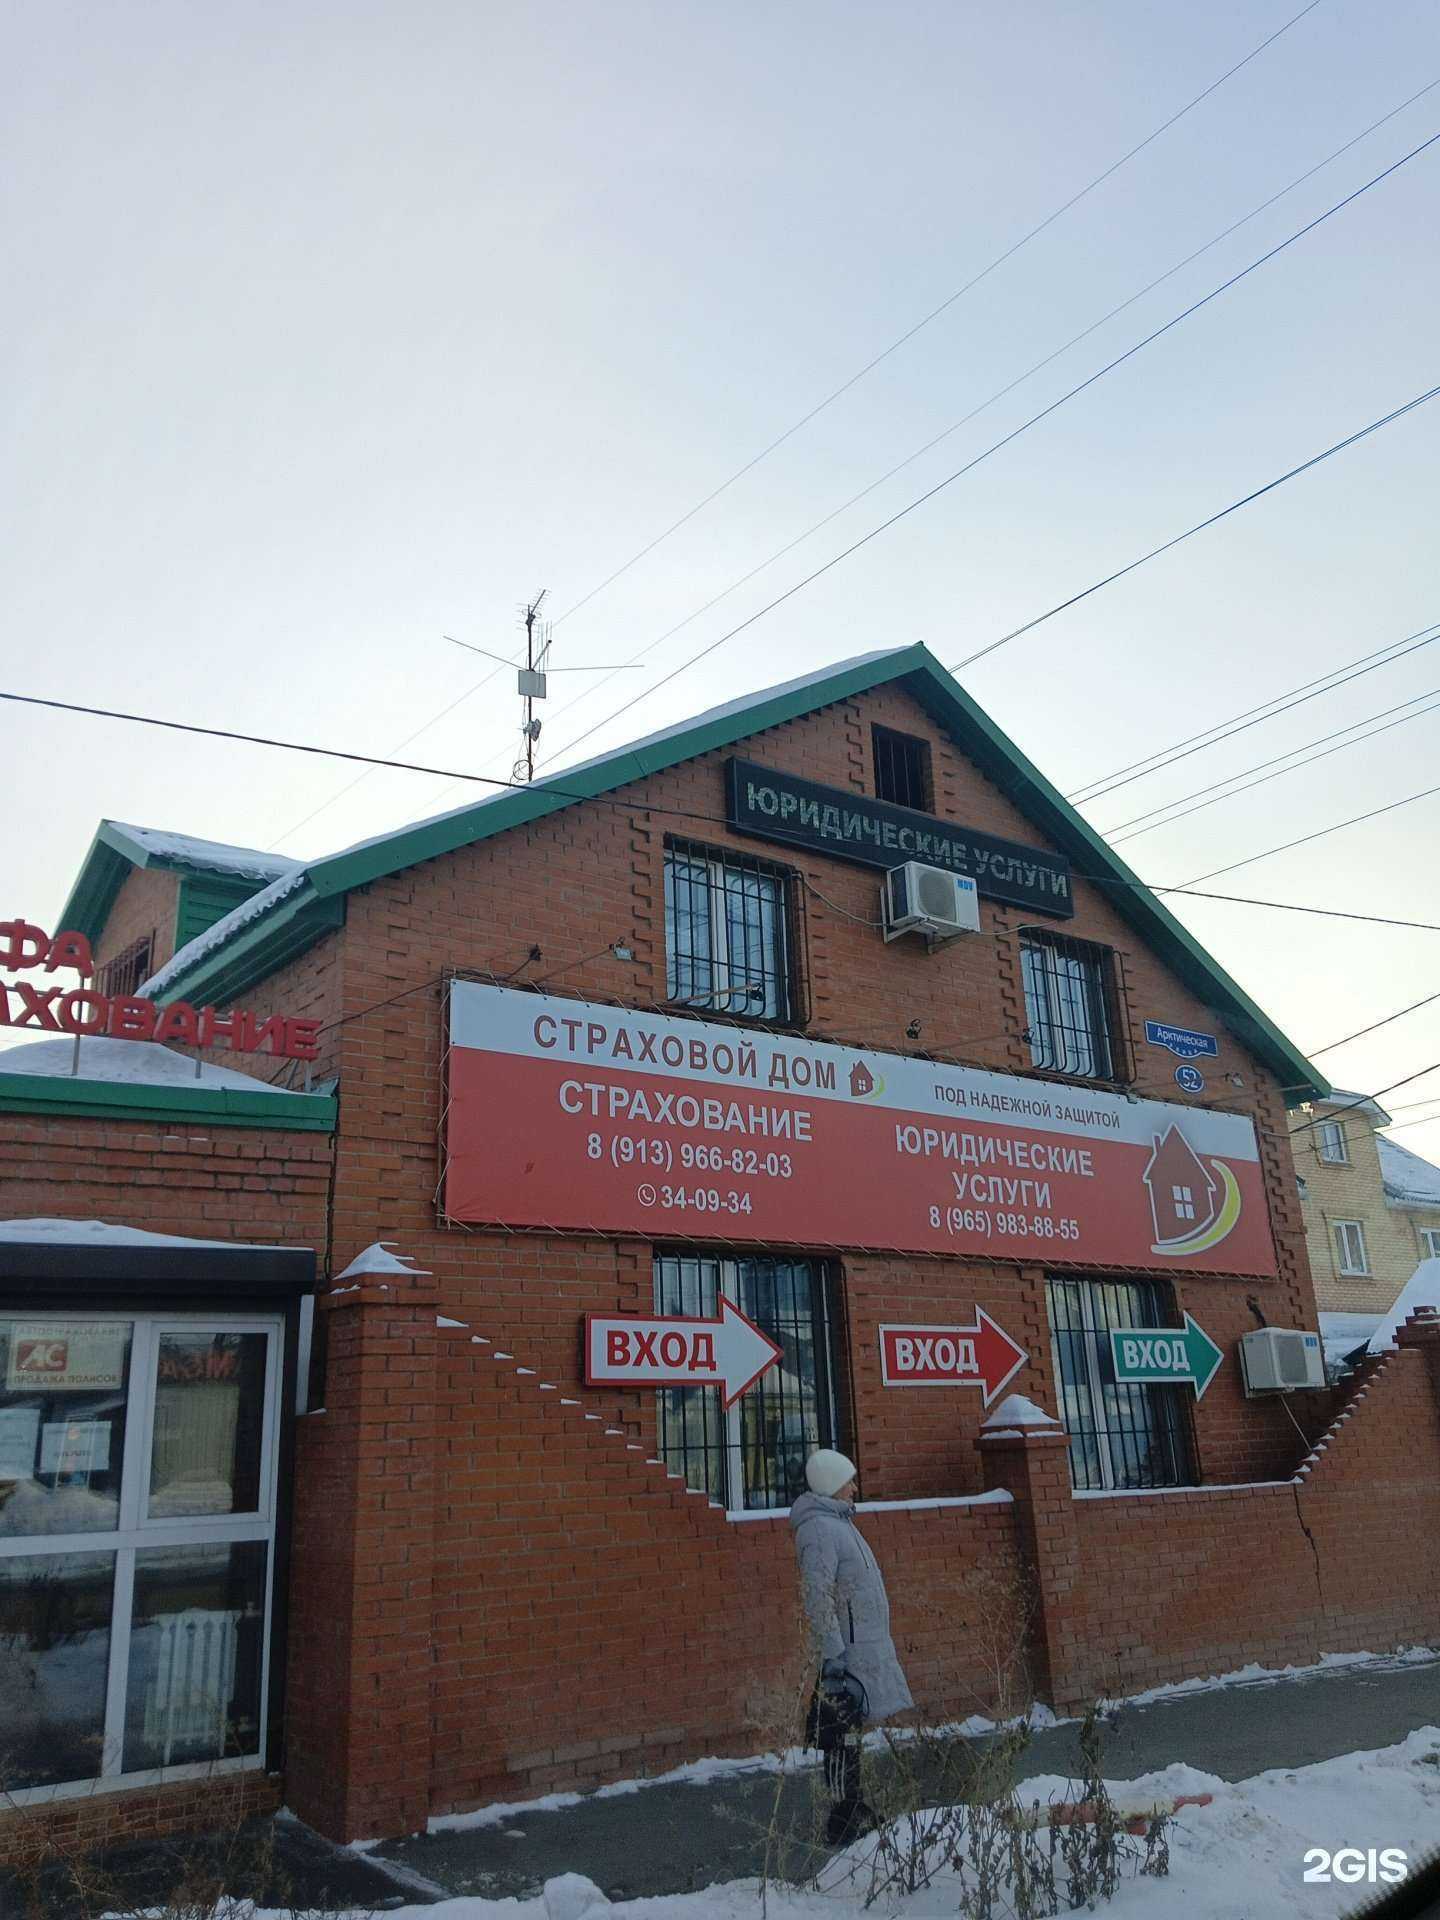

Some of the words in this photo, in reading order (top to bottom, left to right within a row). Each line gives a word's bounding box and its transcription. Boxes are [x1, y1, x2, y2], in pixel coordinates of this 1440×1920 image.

[748, 782, 968, 870] ЮРИДИЧЕСКИЕ
[973, 847, 1068, 897] УСЛУГИ
[533, 1014, 757, 1079] СТРАХОВОЙ
[768, 1053, 837, 1090] ДОМ
[1157, 1028, 1208, 1049] Арктическая
[1182, 1069, 1198, 1088] 52
[558, 1080, 813, 1141] СТРАХОВАНИЕ
[934, 1084, 967, 1106] ПОД
[970, 1090, 1051, 1118] НАДЕЖНОЙ
[1055, 1105, 1121, 1129] ЗАЩИТОЙ
[587, 1133, 602, 1159] 8
[611, 1135, 674, 1172] (913)
[681, 1143, 793, 1178] 966-82-03
[895, 1124, 1095, 1177] ЮРИДИЧЕСКИЕ
[660, 1186, 753, 1214] 34-09-34
[953, 1171, 1051, 1209] УСЛУГИ
[929, 1206, 940, 1228] 8
[946, 1208, 992, 1239] (965)
[997, 1212, 1080, 1240] 983-88-55
[607, 1330, 717, 1371] ВХОД
[895, 1338, 979, 1373] ВХОД
[1122, 1340, 1191, 1371] ВХОД
